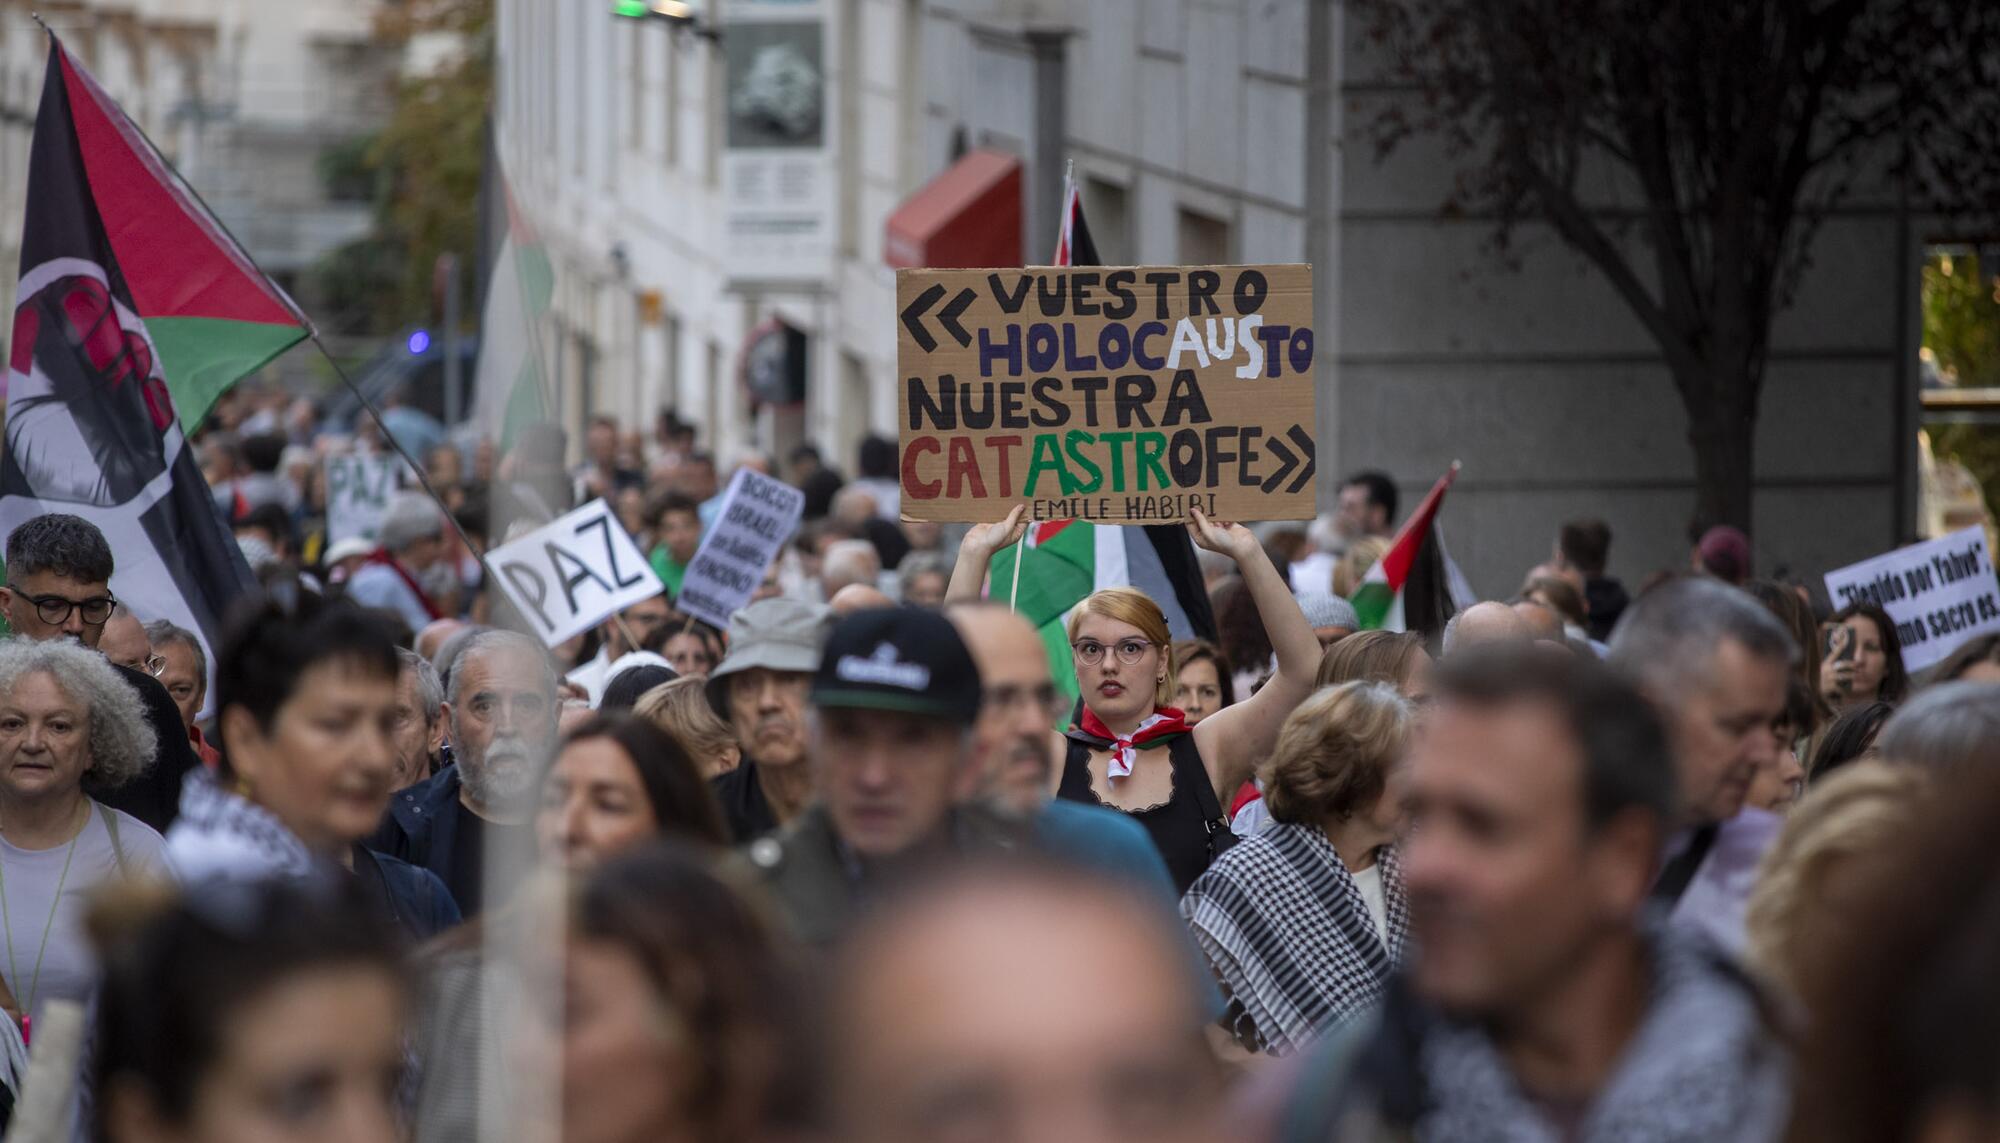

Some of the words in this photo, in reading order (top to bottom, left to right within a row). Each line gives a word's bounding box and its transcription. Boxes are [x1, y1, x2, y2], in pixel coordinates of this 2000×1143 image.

[987, 270, 1268, 320] VUESTRO
[978, 314, 1314, 379] HOLOCAUSTO
[907, 369, 1212, 430] NUESTRA
[1033, 498, 1110, 520] EMILE
[1125, 493, 1218, 519] HABIBI
[501, 515, 644, 634] PAZ
[1905, 564, 1934, 598] por
[1927, 599, 1976, 638] sacro
